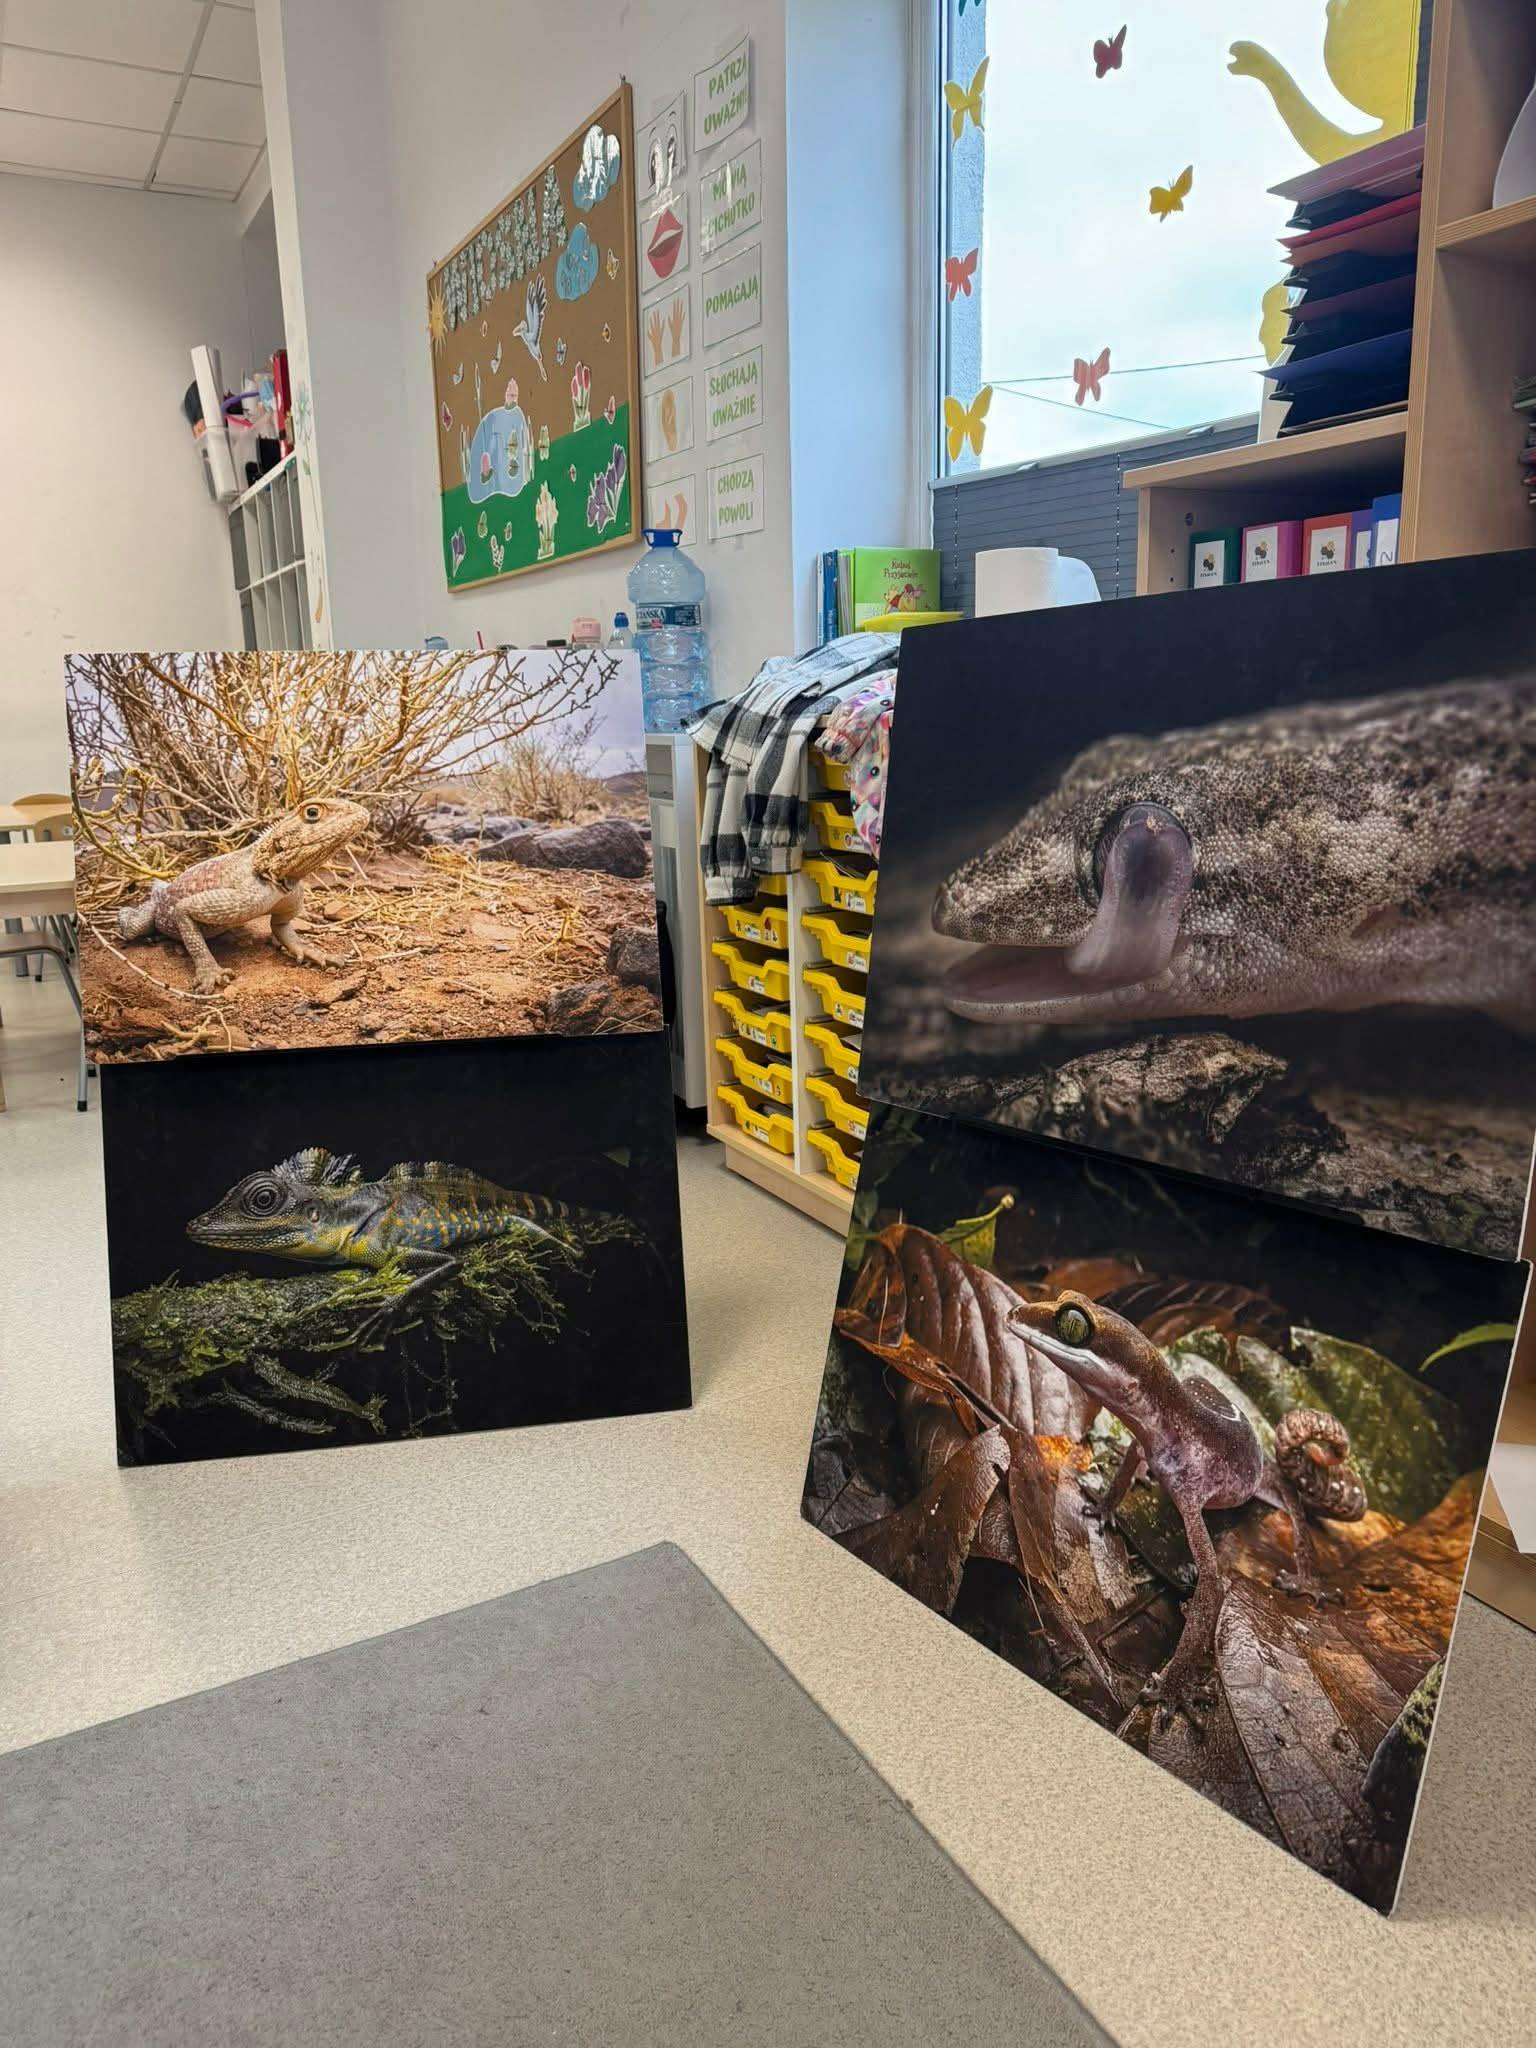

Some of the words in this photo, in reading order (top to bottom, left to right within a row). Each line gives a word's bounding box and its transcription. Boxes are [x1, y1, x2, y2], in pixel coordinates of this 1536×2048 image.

[707, 191, 755, 238] CICHUTKO
[443, 163, 569, 333] WIOSNA
[705, 274, 758, 318] POMAGAJĄ
[712, 393, 757, 427] UWAŻNIE
[718, 501, 754, 527] POWOLI
